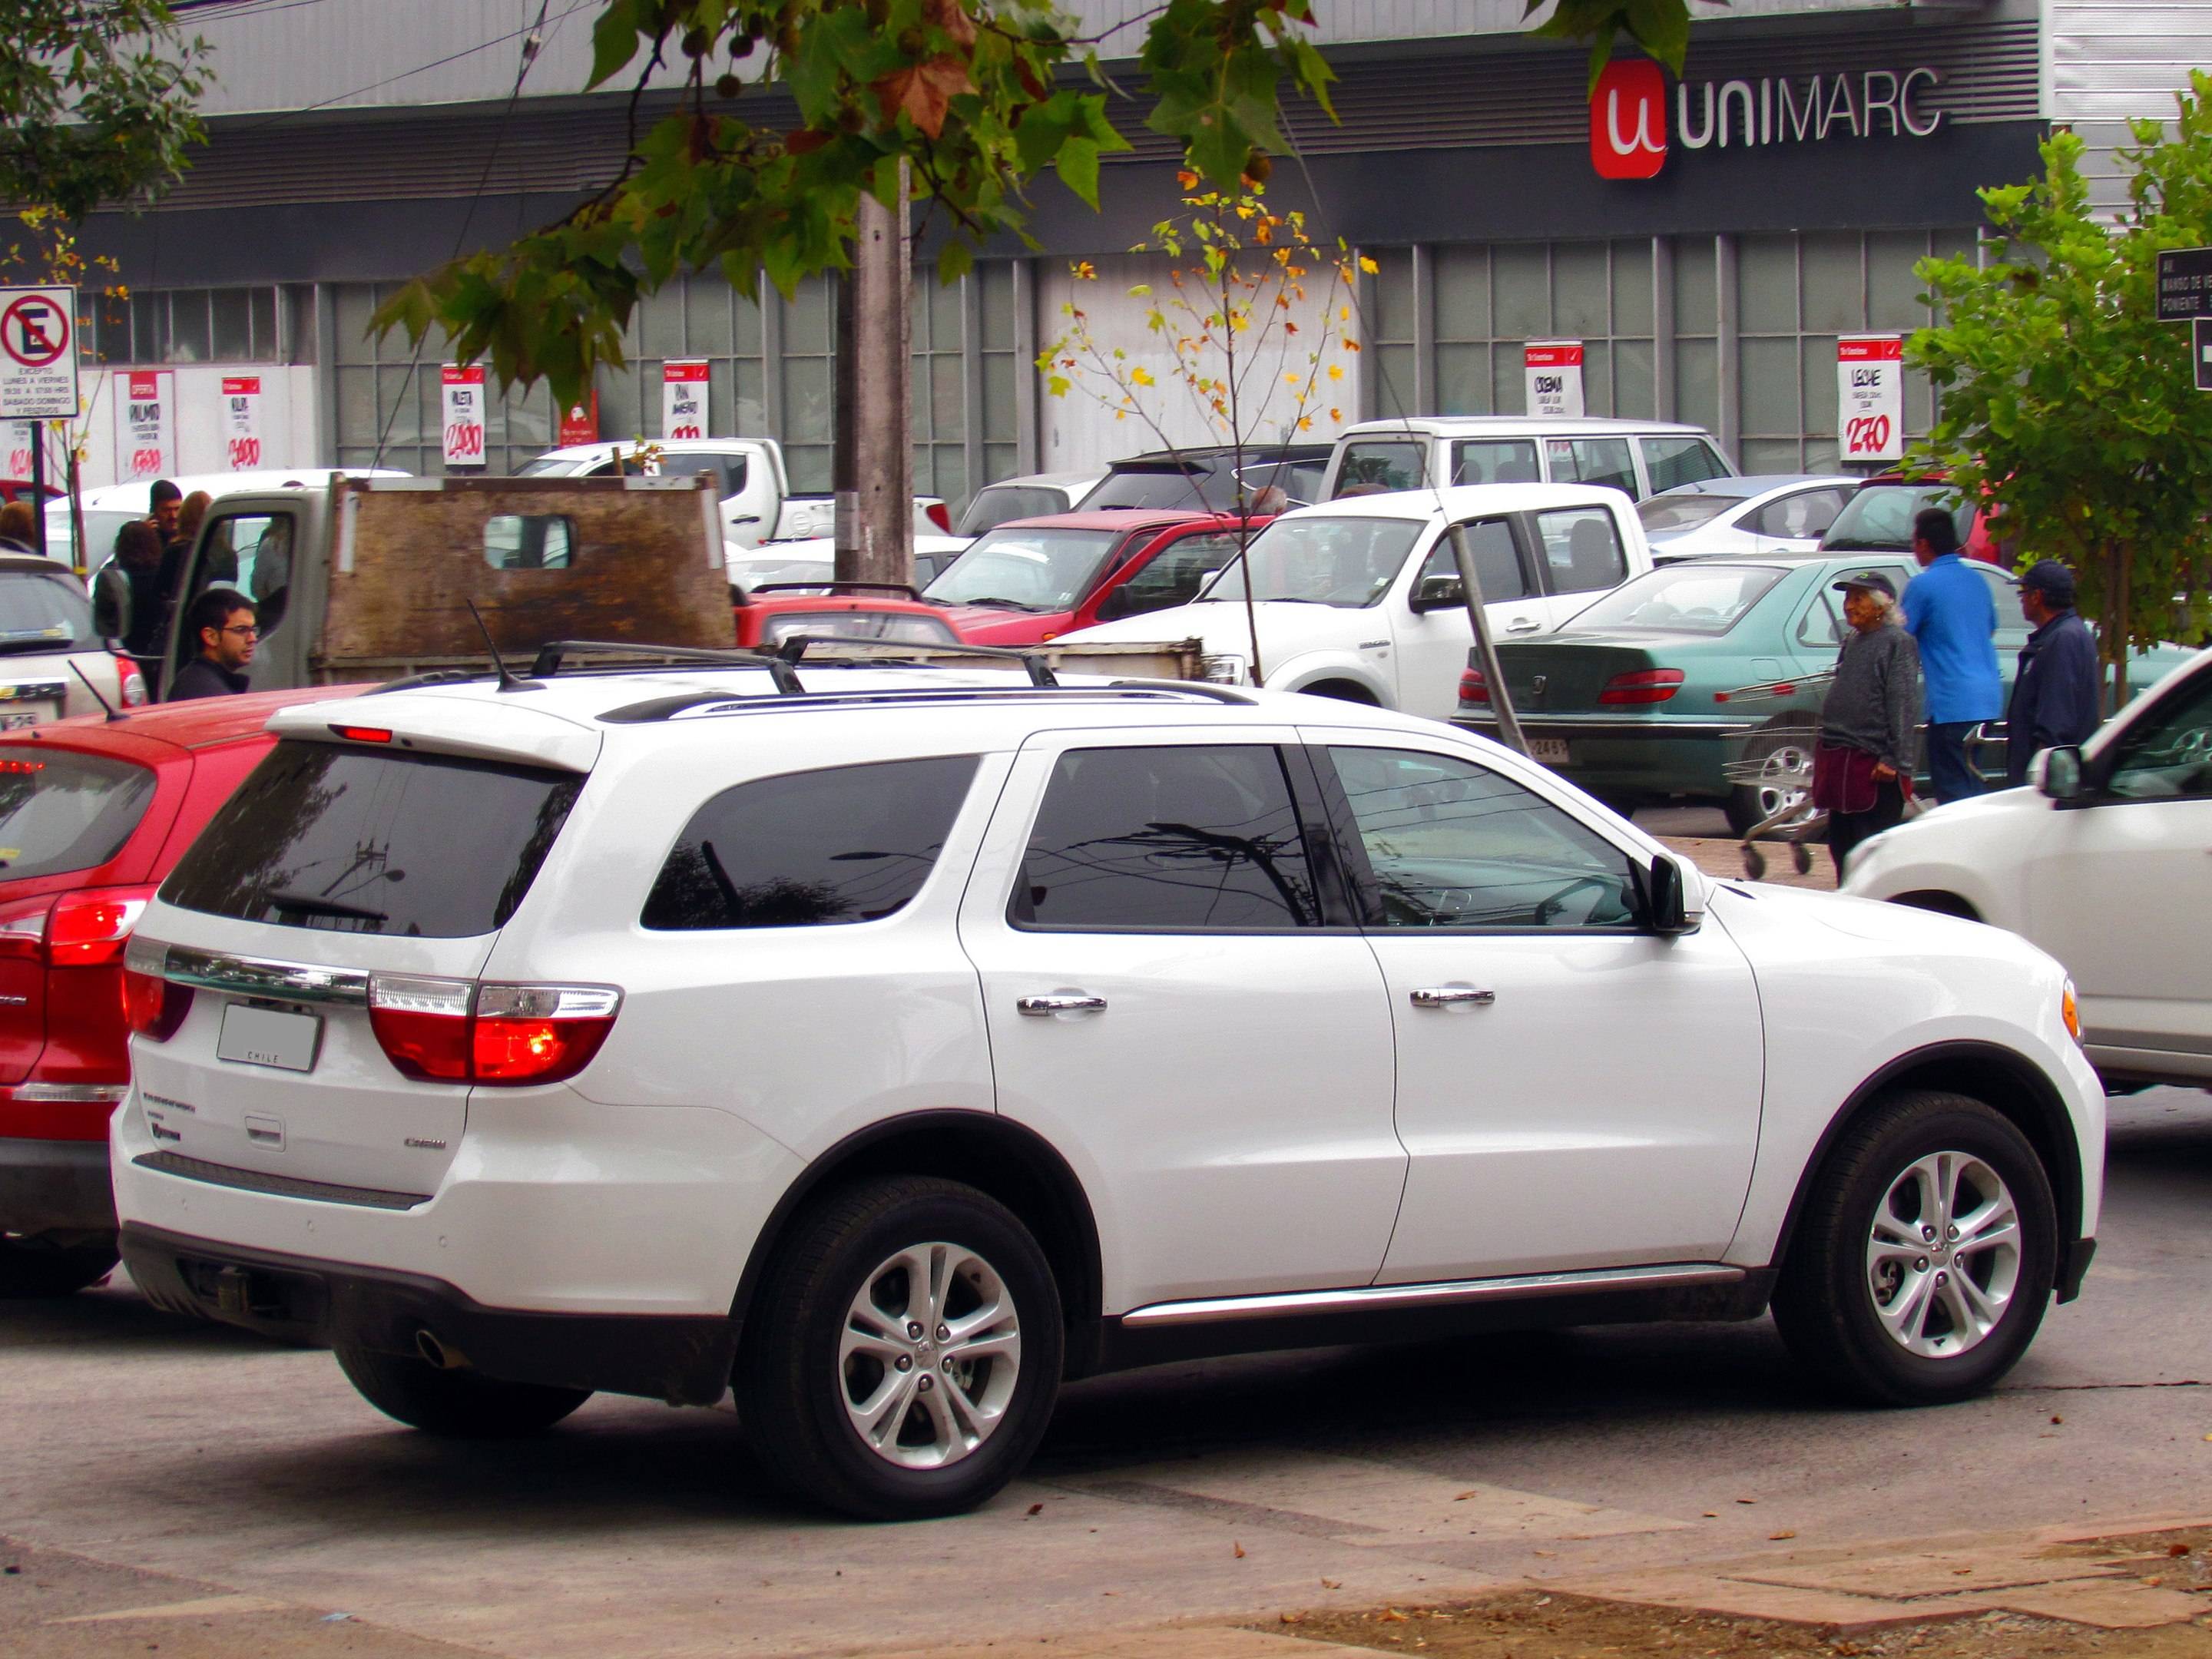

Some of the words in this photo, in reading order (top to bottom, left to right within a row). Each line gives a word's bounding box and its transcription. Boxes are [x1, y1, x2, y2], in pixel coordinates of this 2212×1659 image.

[38, 376, 69, 384] VIERNES
[37, 396, 71, 406] DOMINGO
[1846, 414, 1890, 454] 270
[247, 1051, 279, 1064] CHILE
